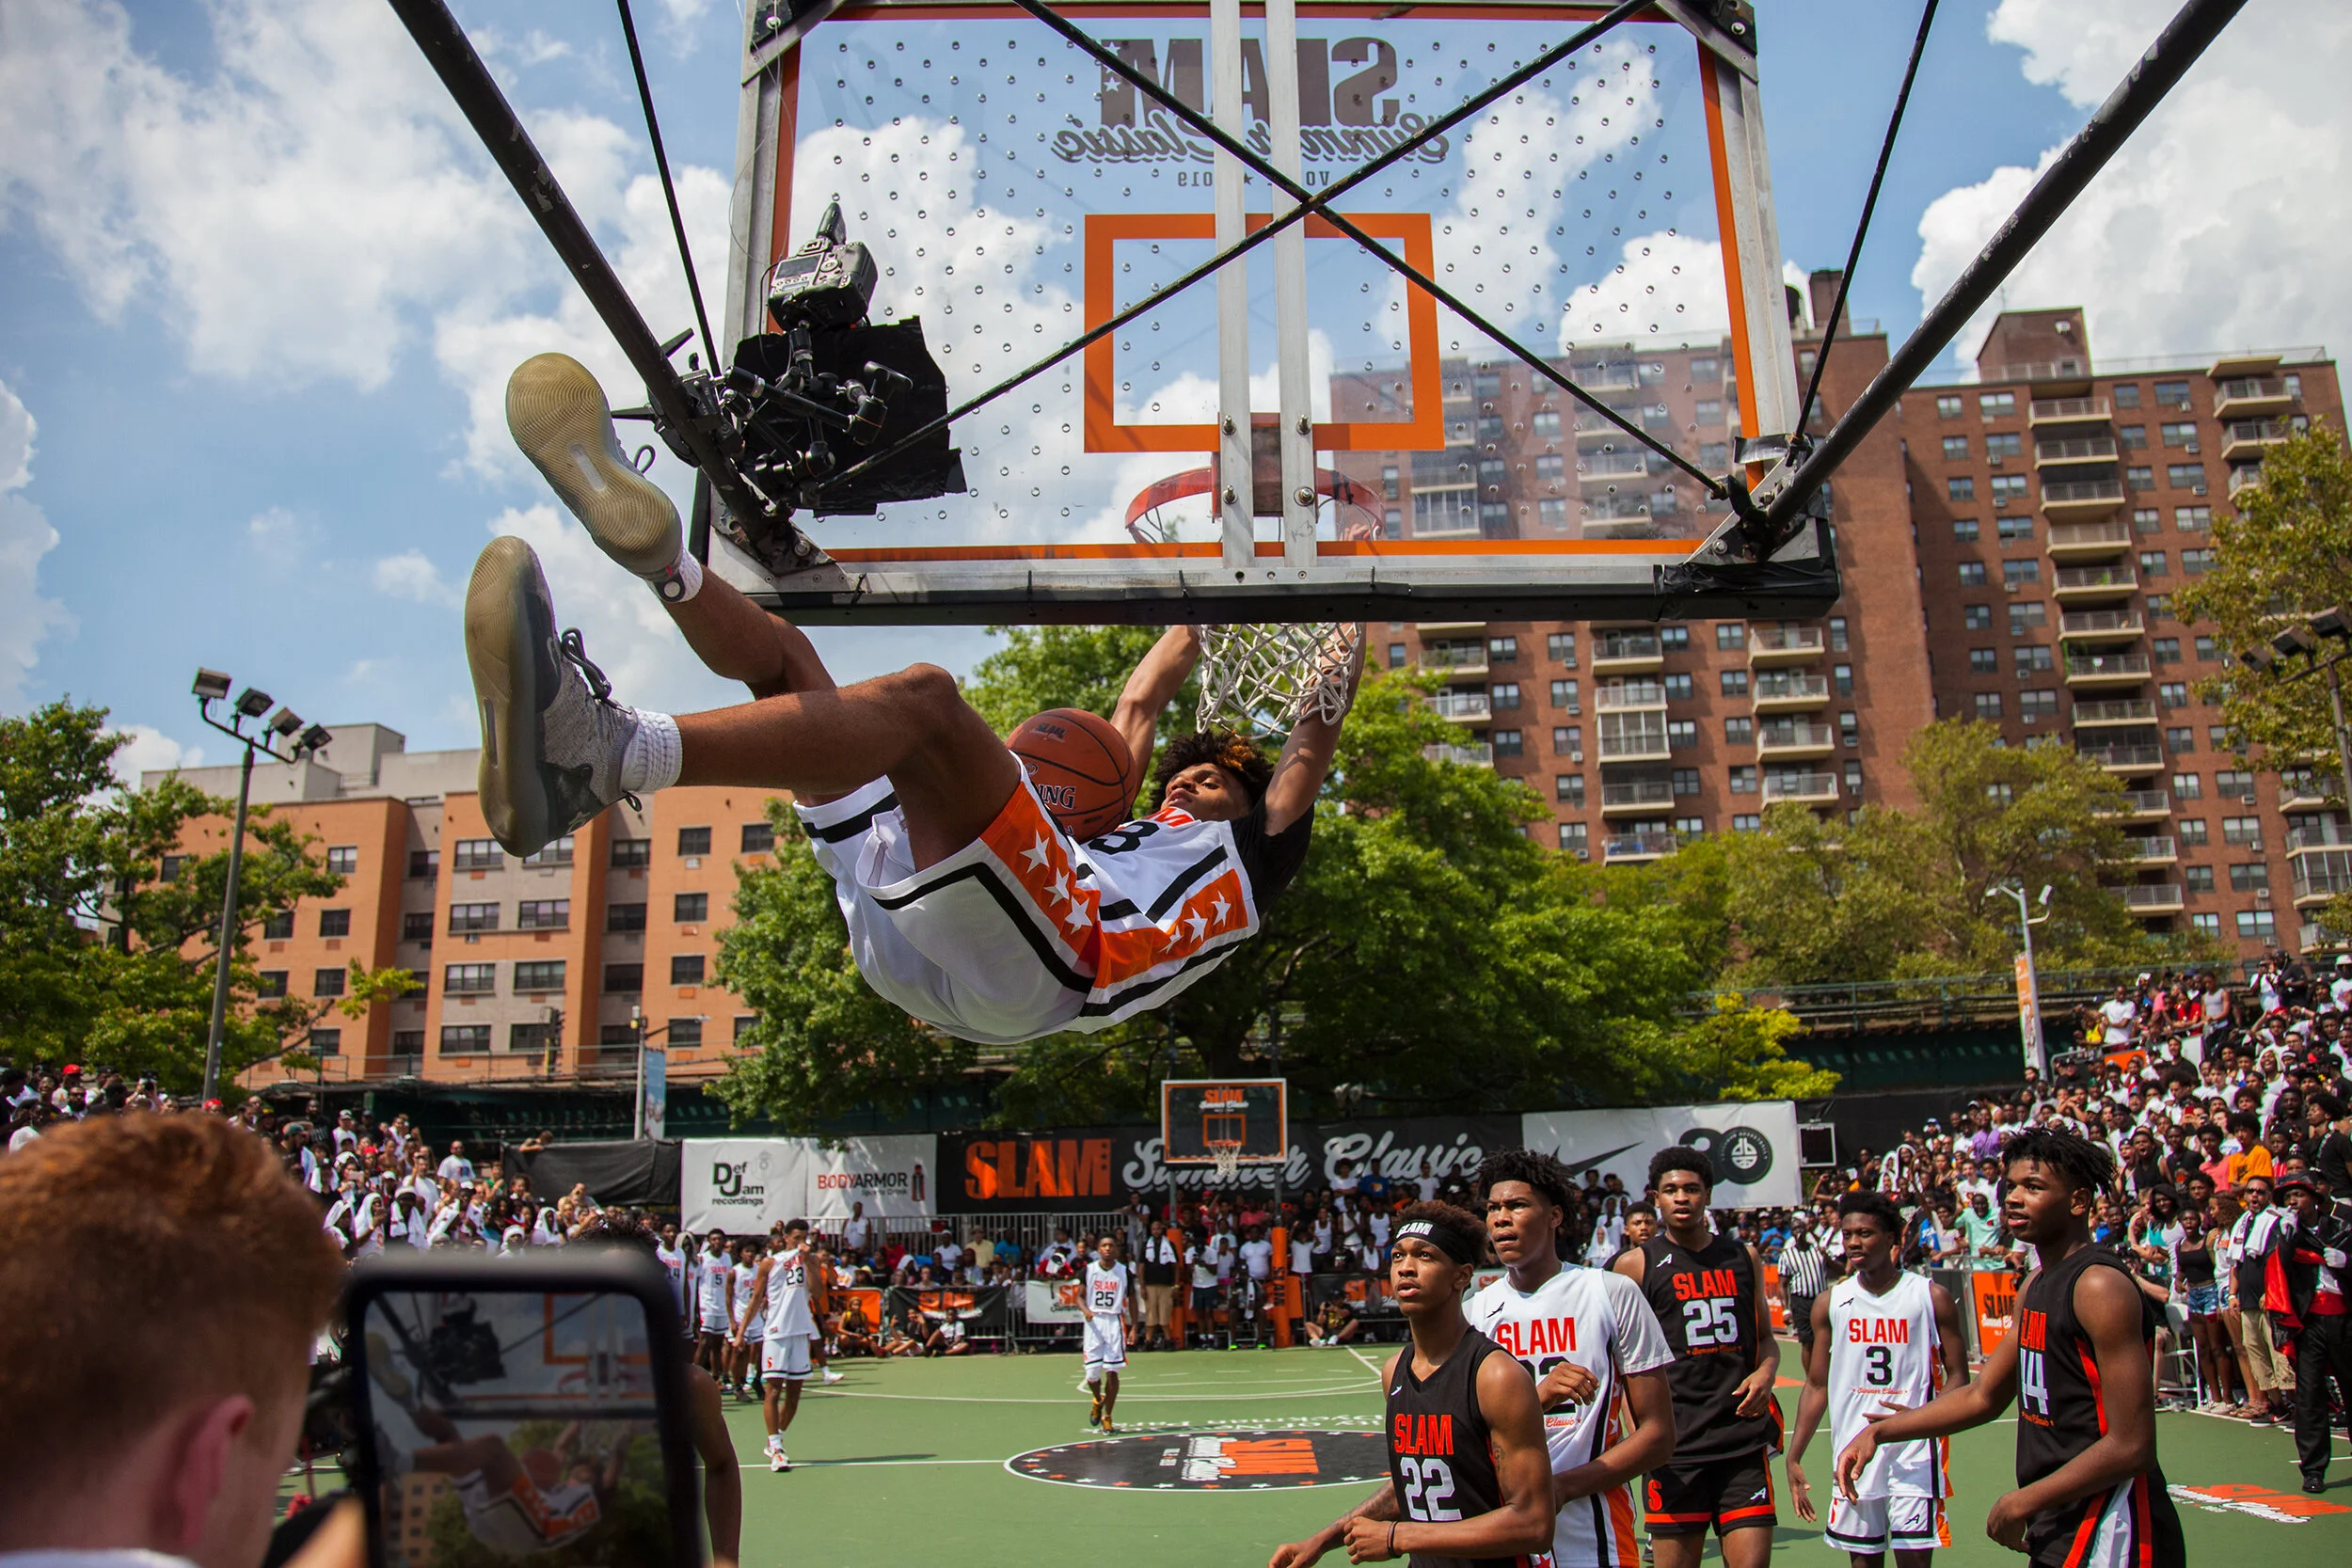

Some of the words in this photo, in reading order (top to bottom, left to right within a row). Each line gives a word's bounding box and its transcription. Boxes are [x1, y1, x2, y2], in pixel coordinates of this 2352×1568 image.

[1204, 1089, 1244, 1102] SLAM
[712, 1162, 748, 1185] Def
[964, 1138, 1111, 1199] SLAM
[1324, 1131, 1488, 1184] Classic
[719, 1175, 764, 1196] Jam
[818, 1172, 908, 1190] BODYARMOR
[712, 1196, 764, 1207] recordings
[715, 1274, 723, 1285] 5
[787, 1267, 804, 1286] 23
[1094, 1280, 1118, 1291] SLAM
[1673, 1269, 1738, 1300] SLAM
[1095, 1291, 1114, 1307] 25
[1682, 1298, 1739, 1347] 25
[1849, 1319, 1909, 1343] SLAM
[2020, 1307, 2047, 1351] LAM
[1496, 1317, 1577, 1356] SLAM
[1866, 1346, 1893, 1386] 3
[2020, 1347, 2049, 1415] 14
[1394, 1414, 1454, 1455] SLAM
[1546, 1417, 1575, 1428] Classic
[1400, 1457, 1463, 1521] 22
[1648, 1480, 1662, 1512] S
